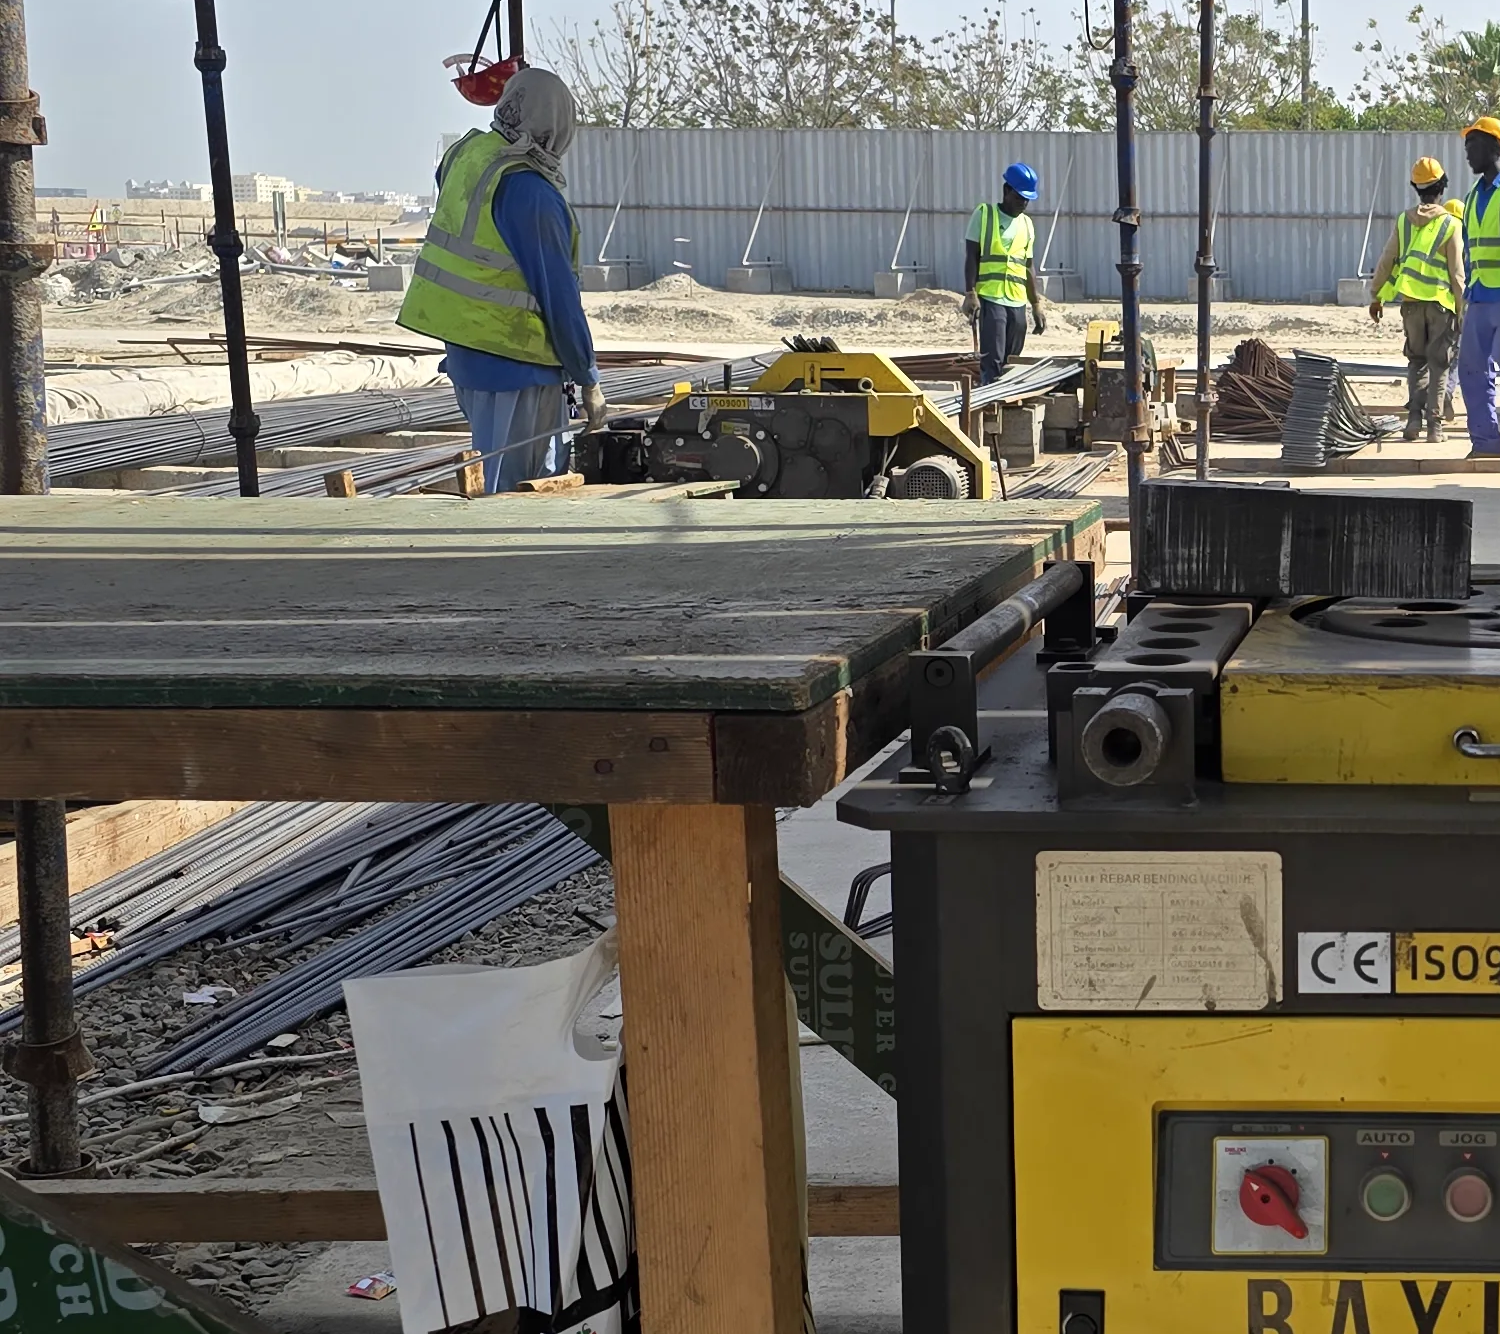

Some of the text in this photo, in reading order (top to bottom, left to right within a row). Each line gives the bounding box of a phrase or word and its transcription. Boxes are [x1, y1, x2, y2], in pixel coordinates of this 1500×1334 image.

[711, 399, 746, 407] ISO9001
[1100, 874, 1140, 884] REBAR
[1143, 874, 1197, 884] BENDING
[1200, 874, 1254, 884] MACHINE
[1310, 941, 1379, 984] CE
[1361, 1133, 1410, 1143] AUTO
[1450, 1133, 1486, 1144] JOG
